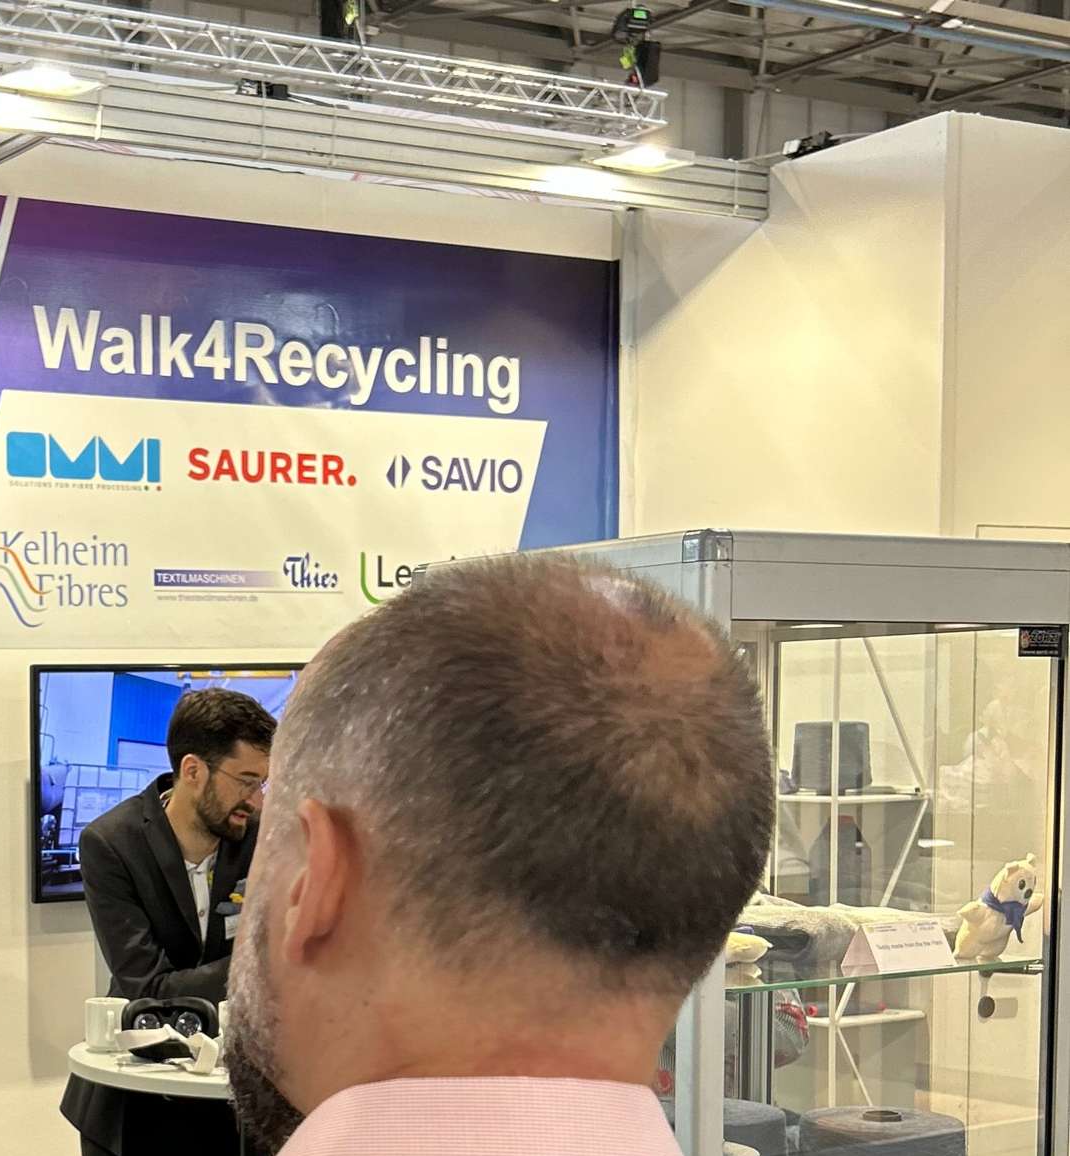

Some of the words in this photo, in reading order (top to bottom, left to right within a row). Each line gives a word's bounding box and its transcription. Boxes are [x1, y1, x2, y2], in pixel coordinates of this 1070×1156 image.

[33, 304, 521, 414] Walk4Recycling
[421, 455, 523, 494] SAVIO
[0, 531, 129, 567] Kelheim
[35, 573, 129, 607] Fibres
[156, 572, 246, 584] TEXTILMASCHINEN
